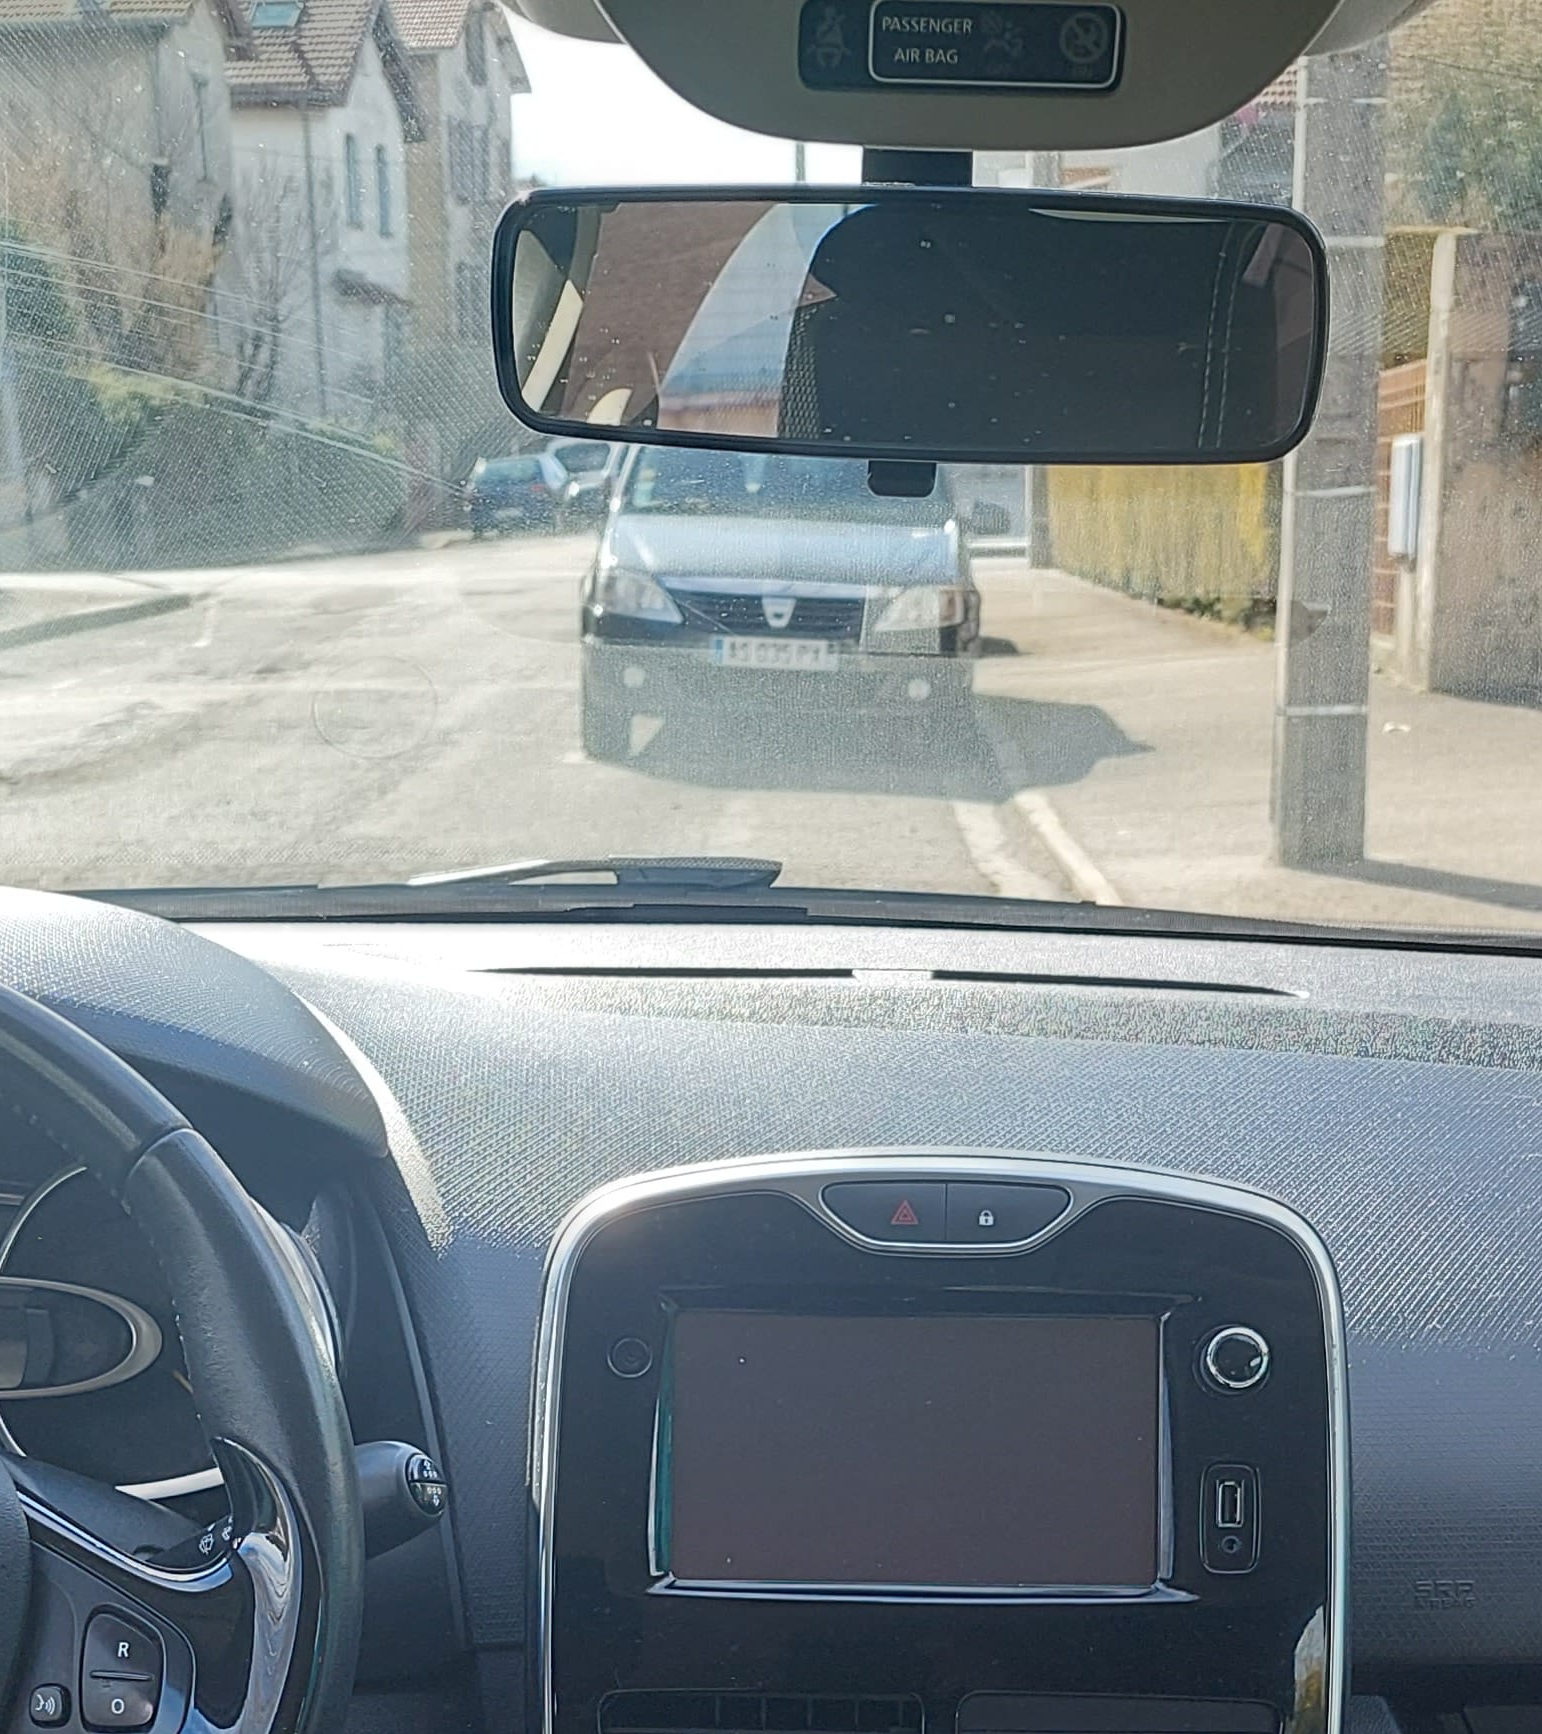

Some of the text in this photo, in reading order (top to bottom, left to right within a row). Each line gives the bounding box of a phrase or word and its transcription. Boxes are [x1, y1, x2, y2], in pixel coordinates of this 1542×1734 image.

[881, 15, 974, 35] PASSENGER
[893, 47, 959, 65] AIR BAG
[117, 1641, 130, 1658] R
